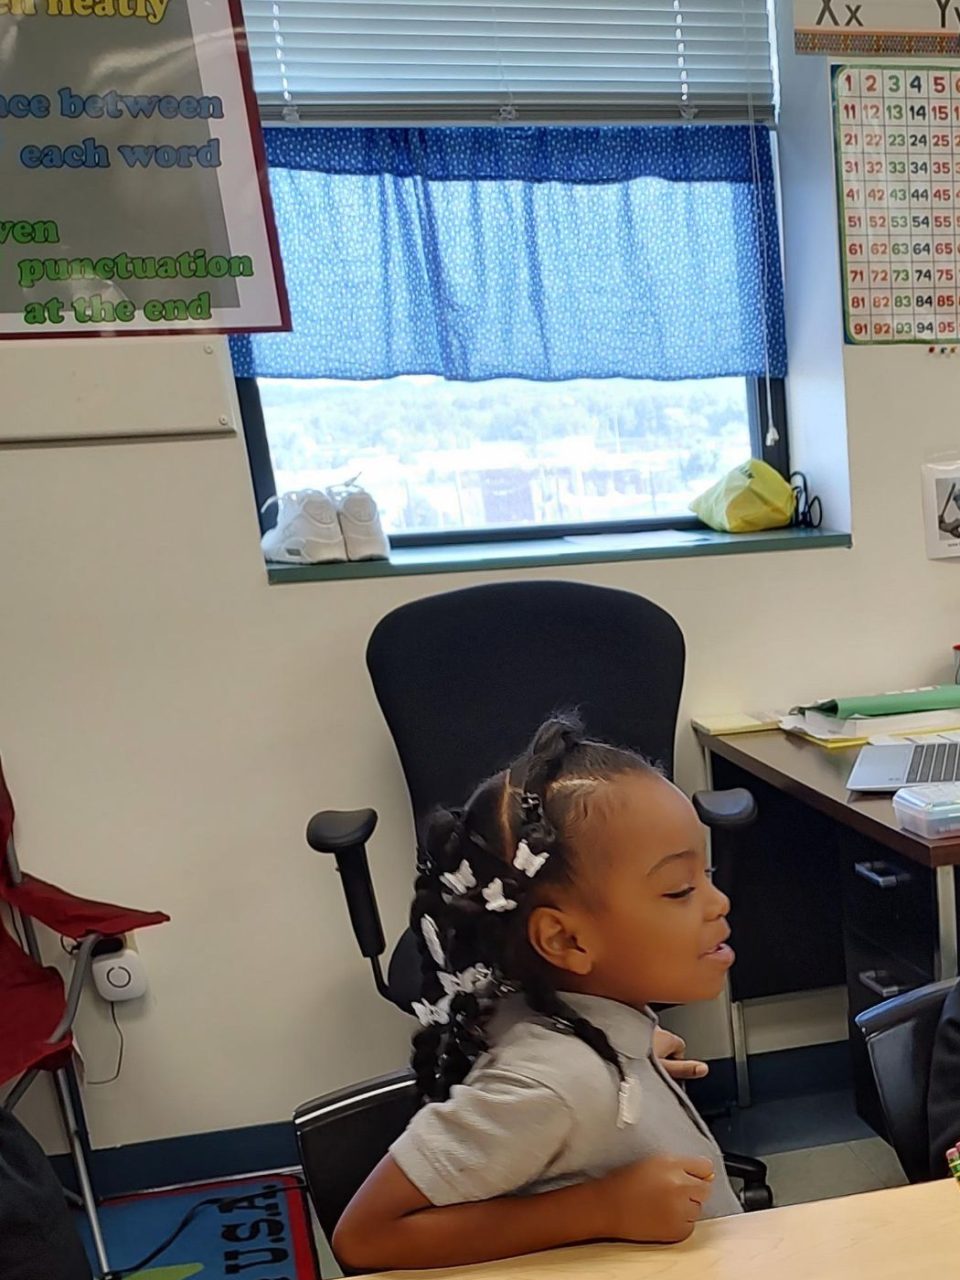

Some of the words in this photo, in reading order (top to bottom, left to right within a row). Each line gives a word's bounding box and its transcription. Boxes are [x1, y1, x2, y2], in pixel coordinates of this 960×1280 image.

[845, 74, 851, 91] 1
[865, 75, 876, 92] 2
[888, 75, 900, 92] 3
[910, 76, 921, 93] 4
[934, 76, 945, 93] 5
[58, 86, 224, 119] between
[844, 104, 855, 119] 11
[887, 104, 903, 120] 13
[910, 105, 926, 120] 14
[932, 106, 948, 120] 15
[844, 133, 858, 145] 21
[888, 134, 905, 146] 23
[910, 134, 927, 146] 24
[933, 135, 949, 147] 25
[20, 138, 110, 169] each
[117, 138, 222, 169] word
[845, 161, 858, 173] 31
[889, 161, 906, 174] 33
[910, 162, 928, 174] 34
[933, 162, 950, 174] 35
[911, 189, 928, 201] 44
[933, 189, 950, 201] 45
[848, 215, 861, 228] 51
[912, 216, 929, 228] 54
[934, 216, 951, 228] 55
[849, 243, 863, 255] 61
[913, 243, 930, 255] 64
[935, 243, 953, 255] 65
[17, 249, 254, 288] punctuation
[850, 270, 863, 282] 71
[893, 269, 909, 282] 73
[915, 269, 931, 281] 74
[937, 269, 953, 281] 75
[24, 297, 65, 324] at
[71, 293, 136, 323] the
[143, 291, 212, 322] end
[852, 296, 865, 308] 81
[916, 296, 933, 307] 84
[937, 295, 954, 307] 85
[854, 323, 867, 335] 91
[874, 323, 890, 335] 92
[917, 322, 933, 333] 94
